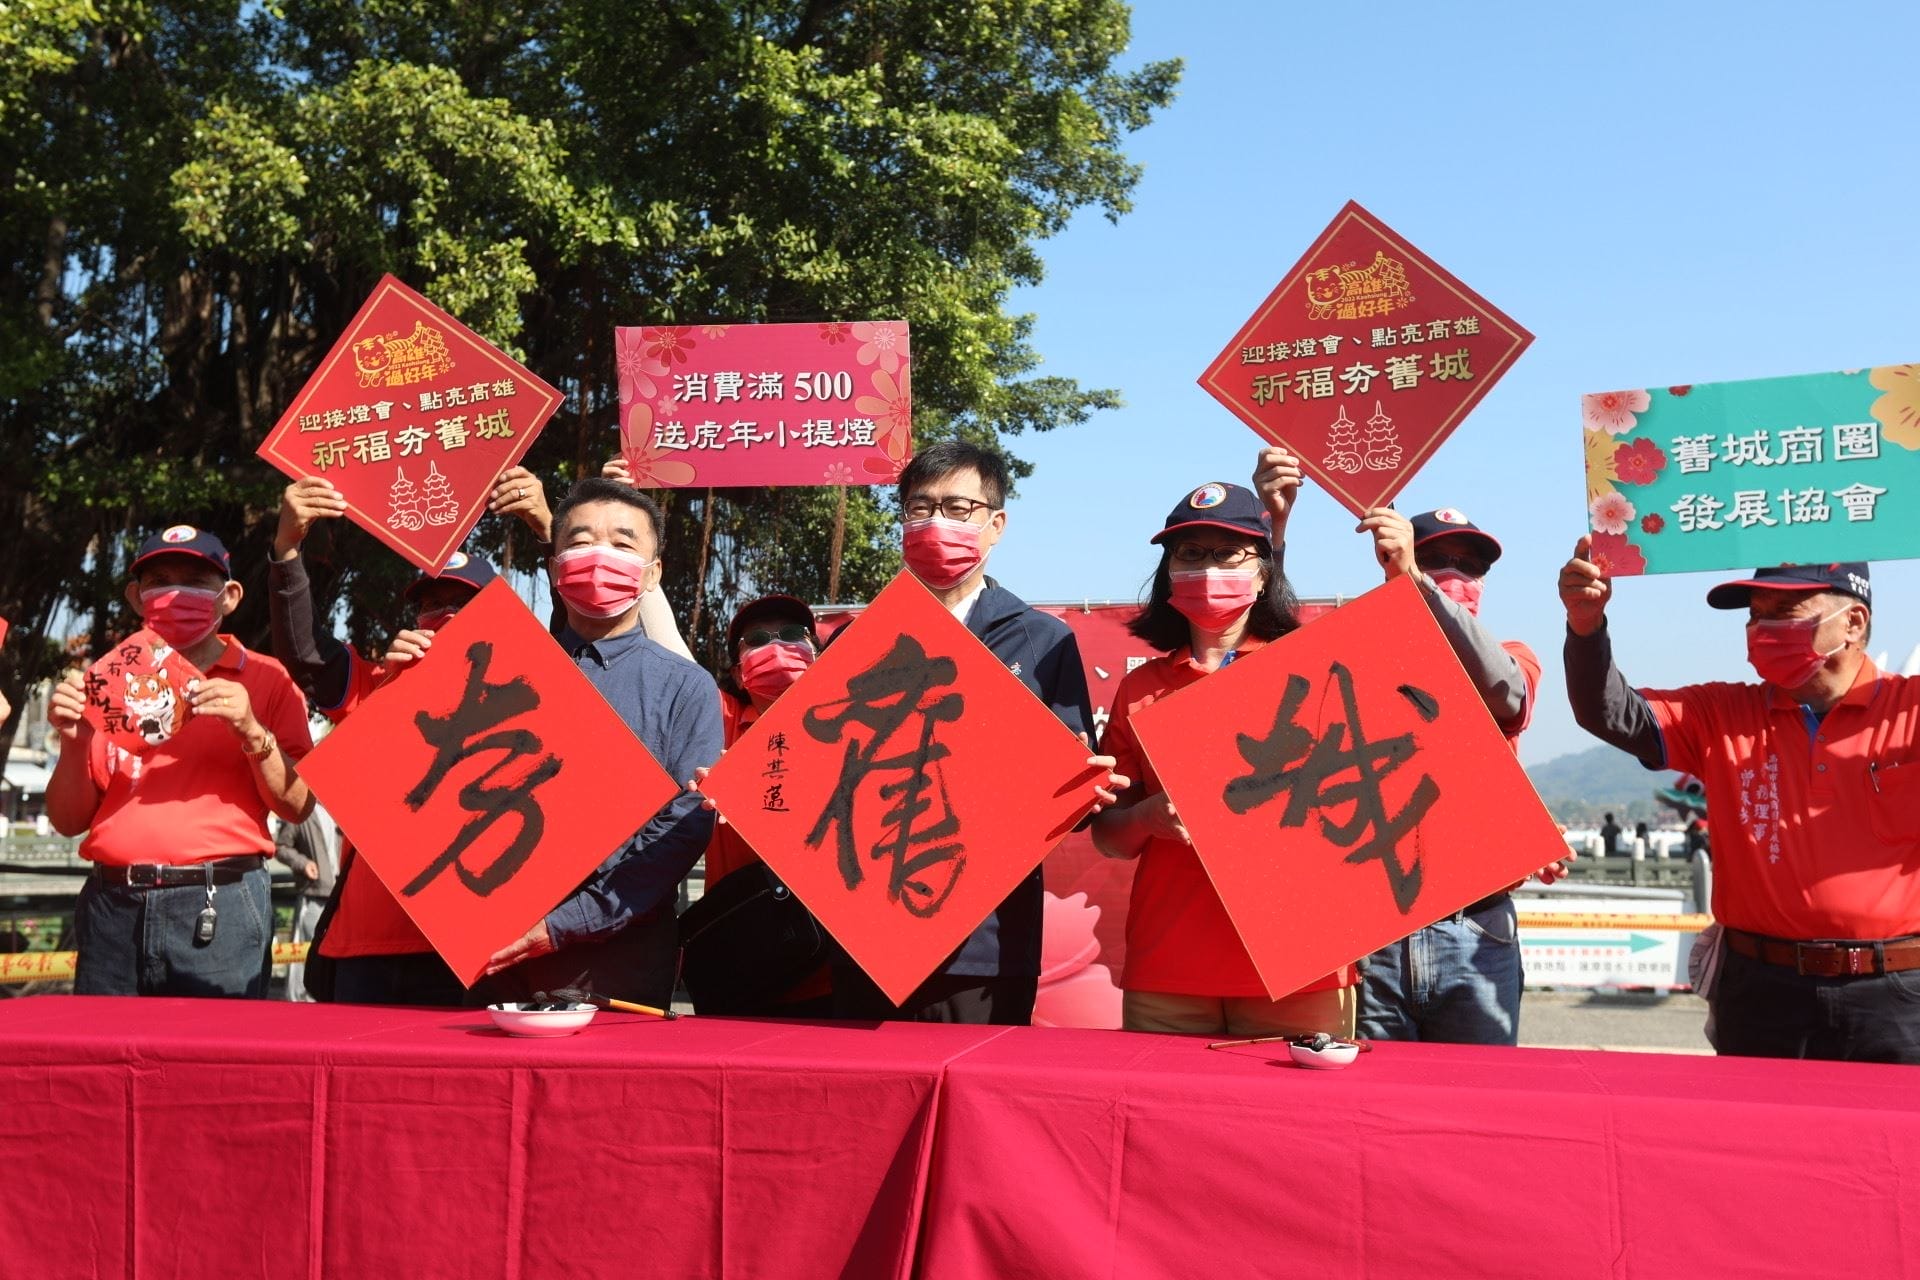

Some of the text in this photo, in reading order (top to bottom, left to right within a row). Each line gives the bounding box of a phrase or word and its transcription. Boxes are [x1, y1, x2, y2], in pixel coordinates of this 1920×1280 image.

[1336, 298, 1396, 320] 過好年
[1242, 315, 1481, 365] 迎接燈會、點亮高雄
[385, 363, 438, 388] 過好年
[673, 371, 852, 403] 消費滿 500
[1251, 348, 1475, 406] 祈福夯舊城
[299, 378, 516, 433] 迎接燈會、點亮高雄
[312, 408, 515, 472] 祈福夯舊城
[654, 418, 876, 450] 送虎年小提燈
[1670, 422, 1880, 474] 舊城商圈
[1670, 482, 1888, 532] 發展協會
[761, 732, 791, 813] 陳其邁
